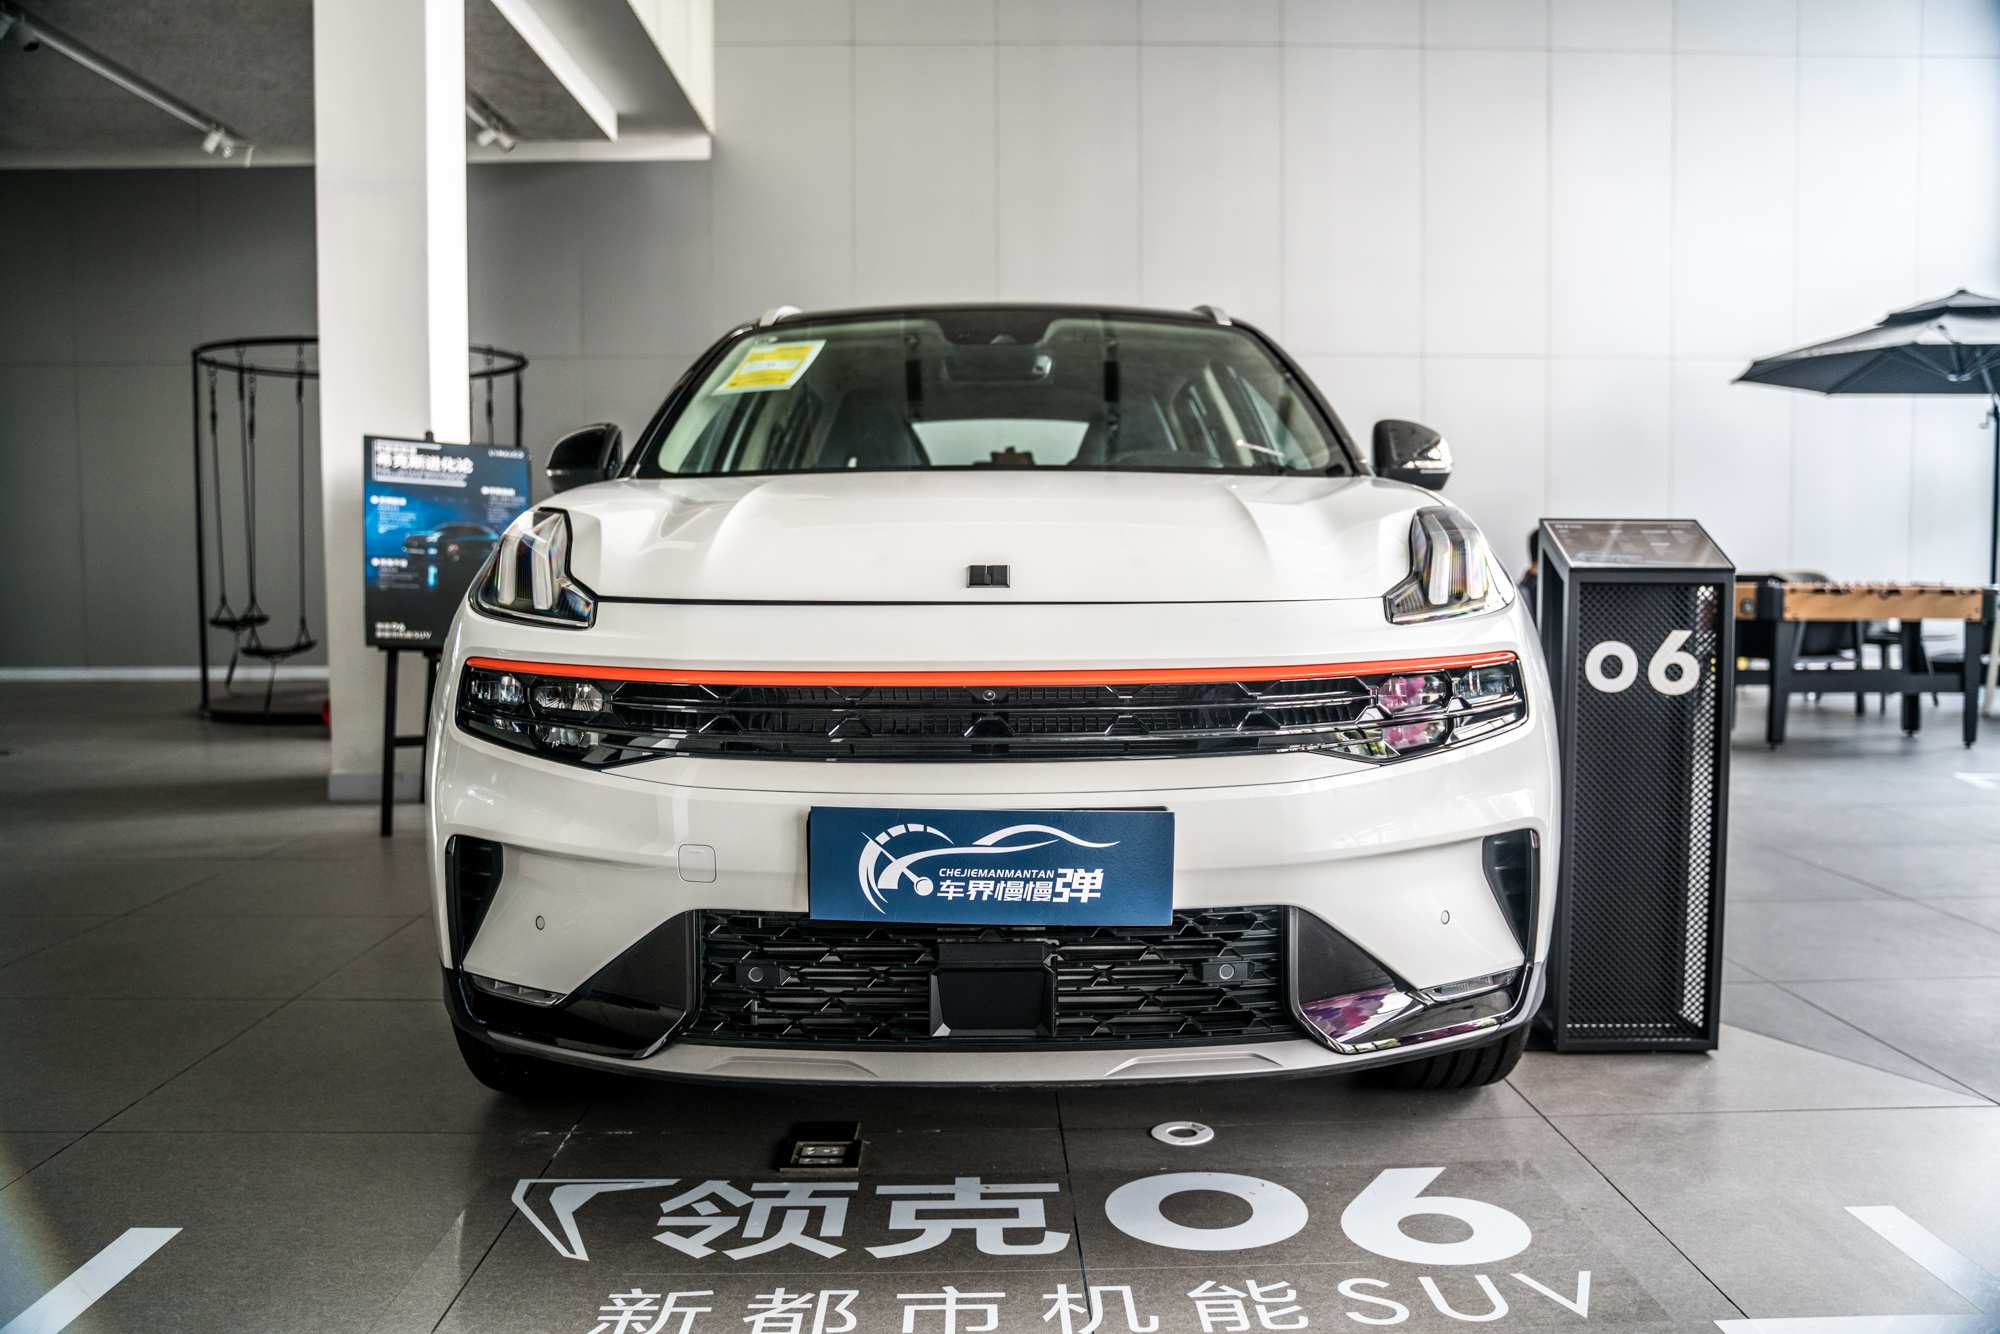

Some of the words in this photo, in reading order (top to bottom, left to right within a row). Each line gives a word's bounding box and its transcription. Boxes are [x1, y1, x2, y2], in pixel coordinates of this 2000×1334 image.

[1585, 629, 1700, 695] 06
[936, 867, 1105, 904] 车界慢慢弹
[938, 868, 1055, 879] CHEJIEMANMANTAN
